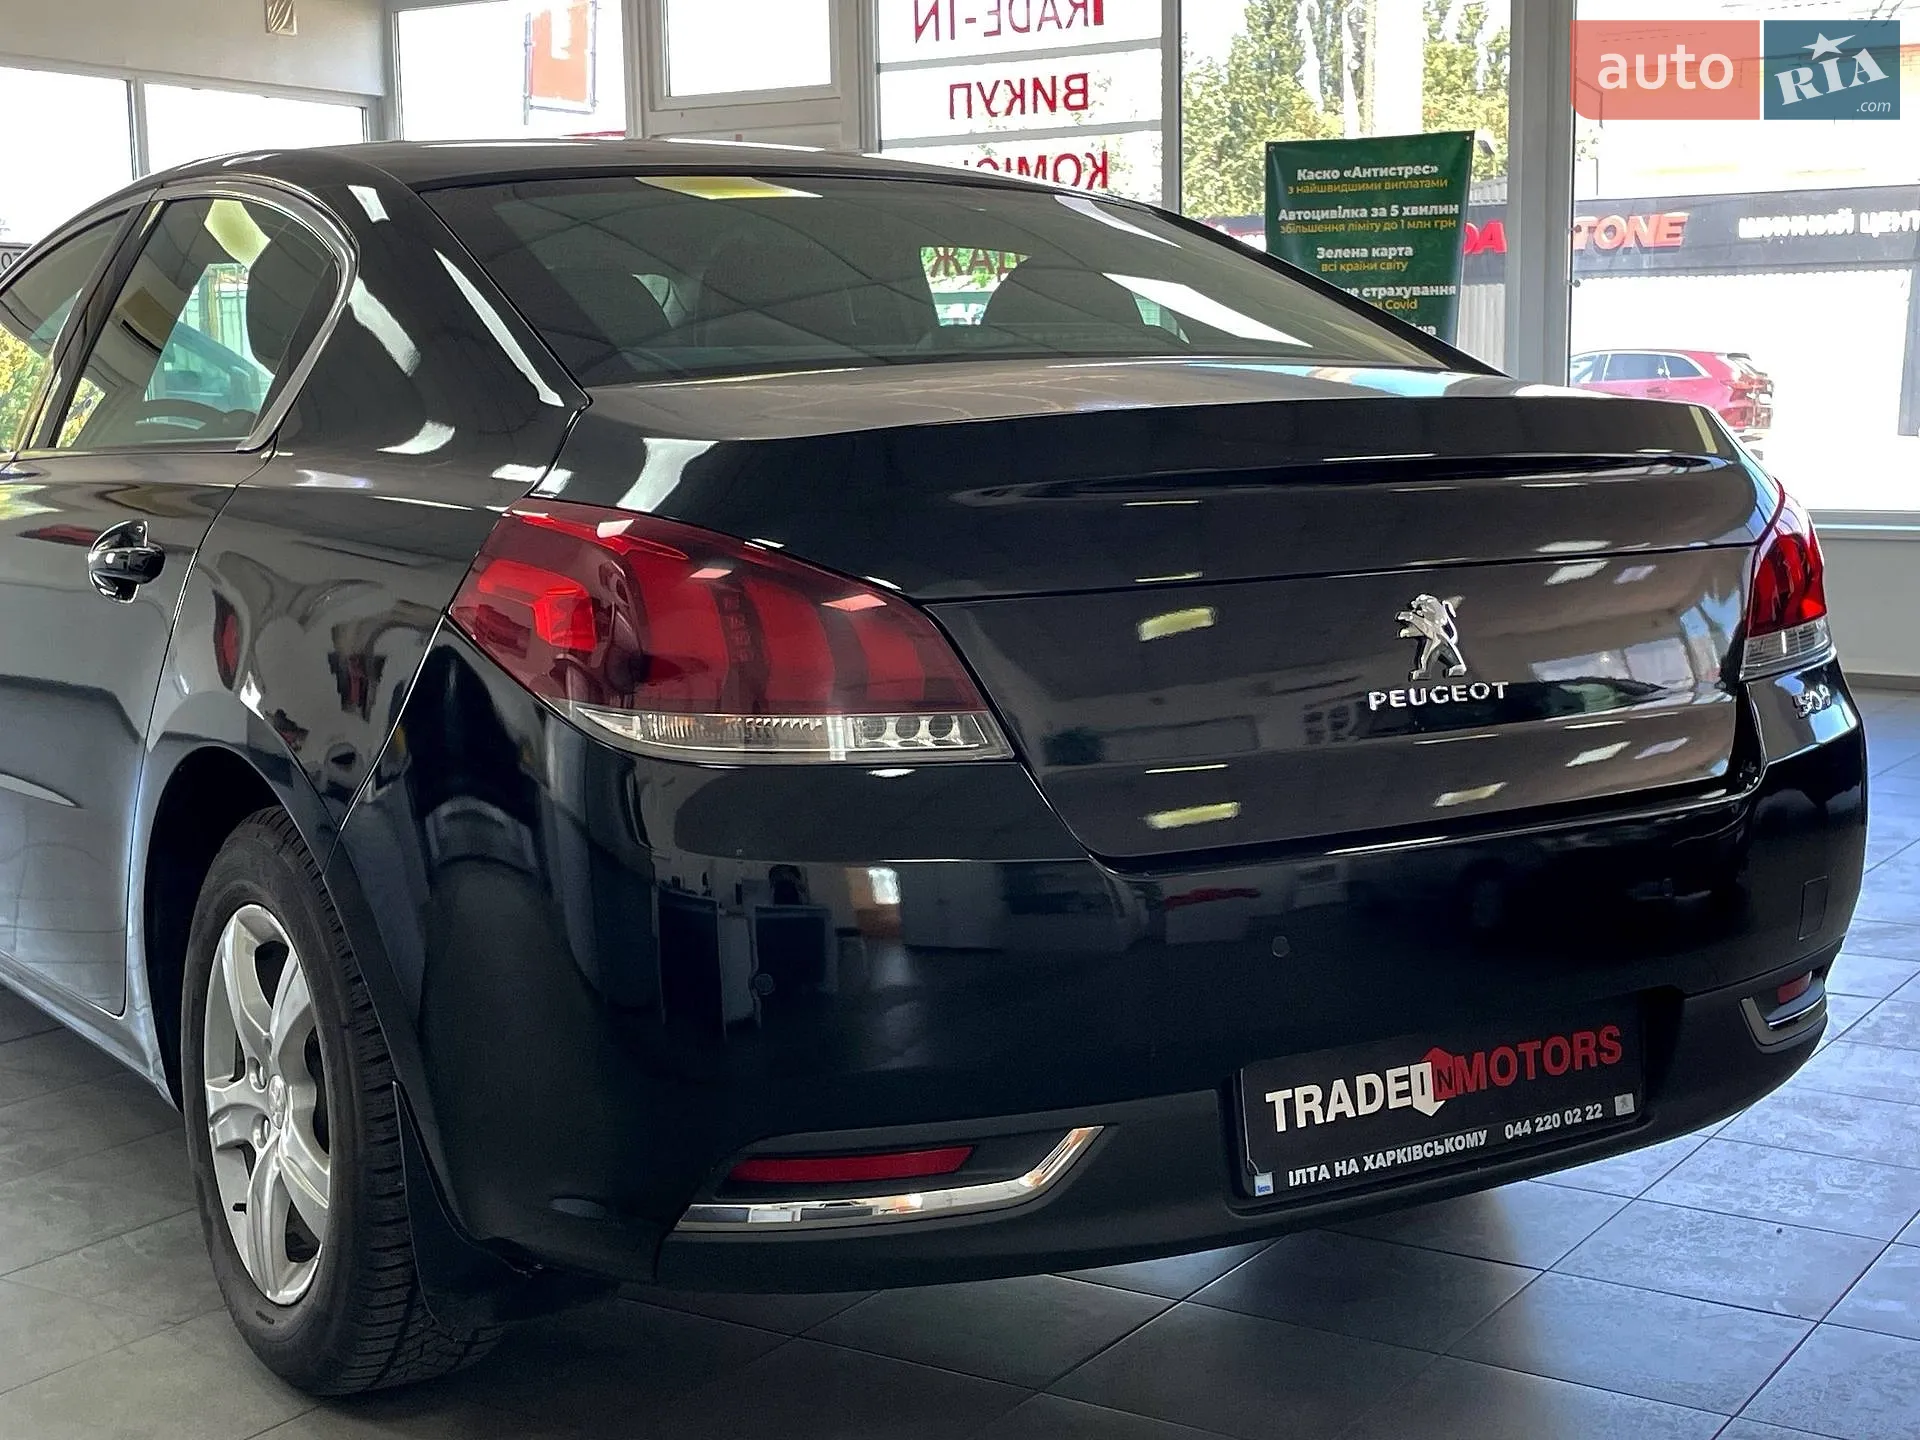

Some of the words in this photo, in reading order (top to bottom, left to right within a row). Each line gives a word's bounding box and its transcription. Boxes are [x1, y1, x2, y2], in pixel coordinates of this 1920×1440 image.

[1297, 168, 1340, 181] Каско
[1343, 164, 1439, 179] «Антистрес»
[1287, 186, 1295, 195] з
[1296, 181, 1382, 194] найшвидшими
[1385, 178, 1448, 191] виплатами
[1278, 206, 1368, 221] Автоцивілка
[1371, 208, 1388, 219] за
[1390, 205, 1399, 217] 5
[1402, 204, 1459, 217] хвилин
[1280, 221, 1345, 234] збільшення
[1348, 221, 1381, 233] ліміту
[1383, 221, 1398, 232] до
[1407, 219, 1432, 230] млн
[1434, 218, 1456, 231] грн
[1316, 246, 1368, 260] Зелена
[1371, 245, 1414, 260] карта
[1321, 263, 1337, 272] всі
[1380, 259, 1408, 272] світу
[1362, 285, 1456, 299] страхування
[1385, 299, 1418, 310] Covid
[1368, 681, 1509, 711] PEUGEOT
[1334, 1158, 1359, 1178] НА
[1363, 1129, 1488, 1172] ХАРКІВСЬКОМУ
[1504, 1119, 1532, 1140] 044
[1535, 1112, 1561, 1133] 220
[1564, 1107, 1583, 1125] 02
[1585, 1103, 1603, 1121] 22
